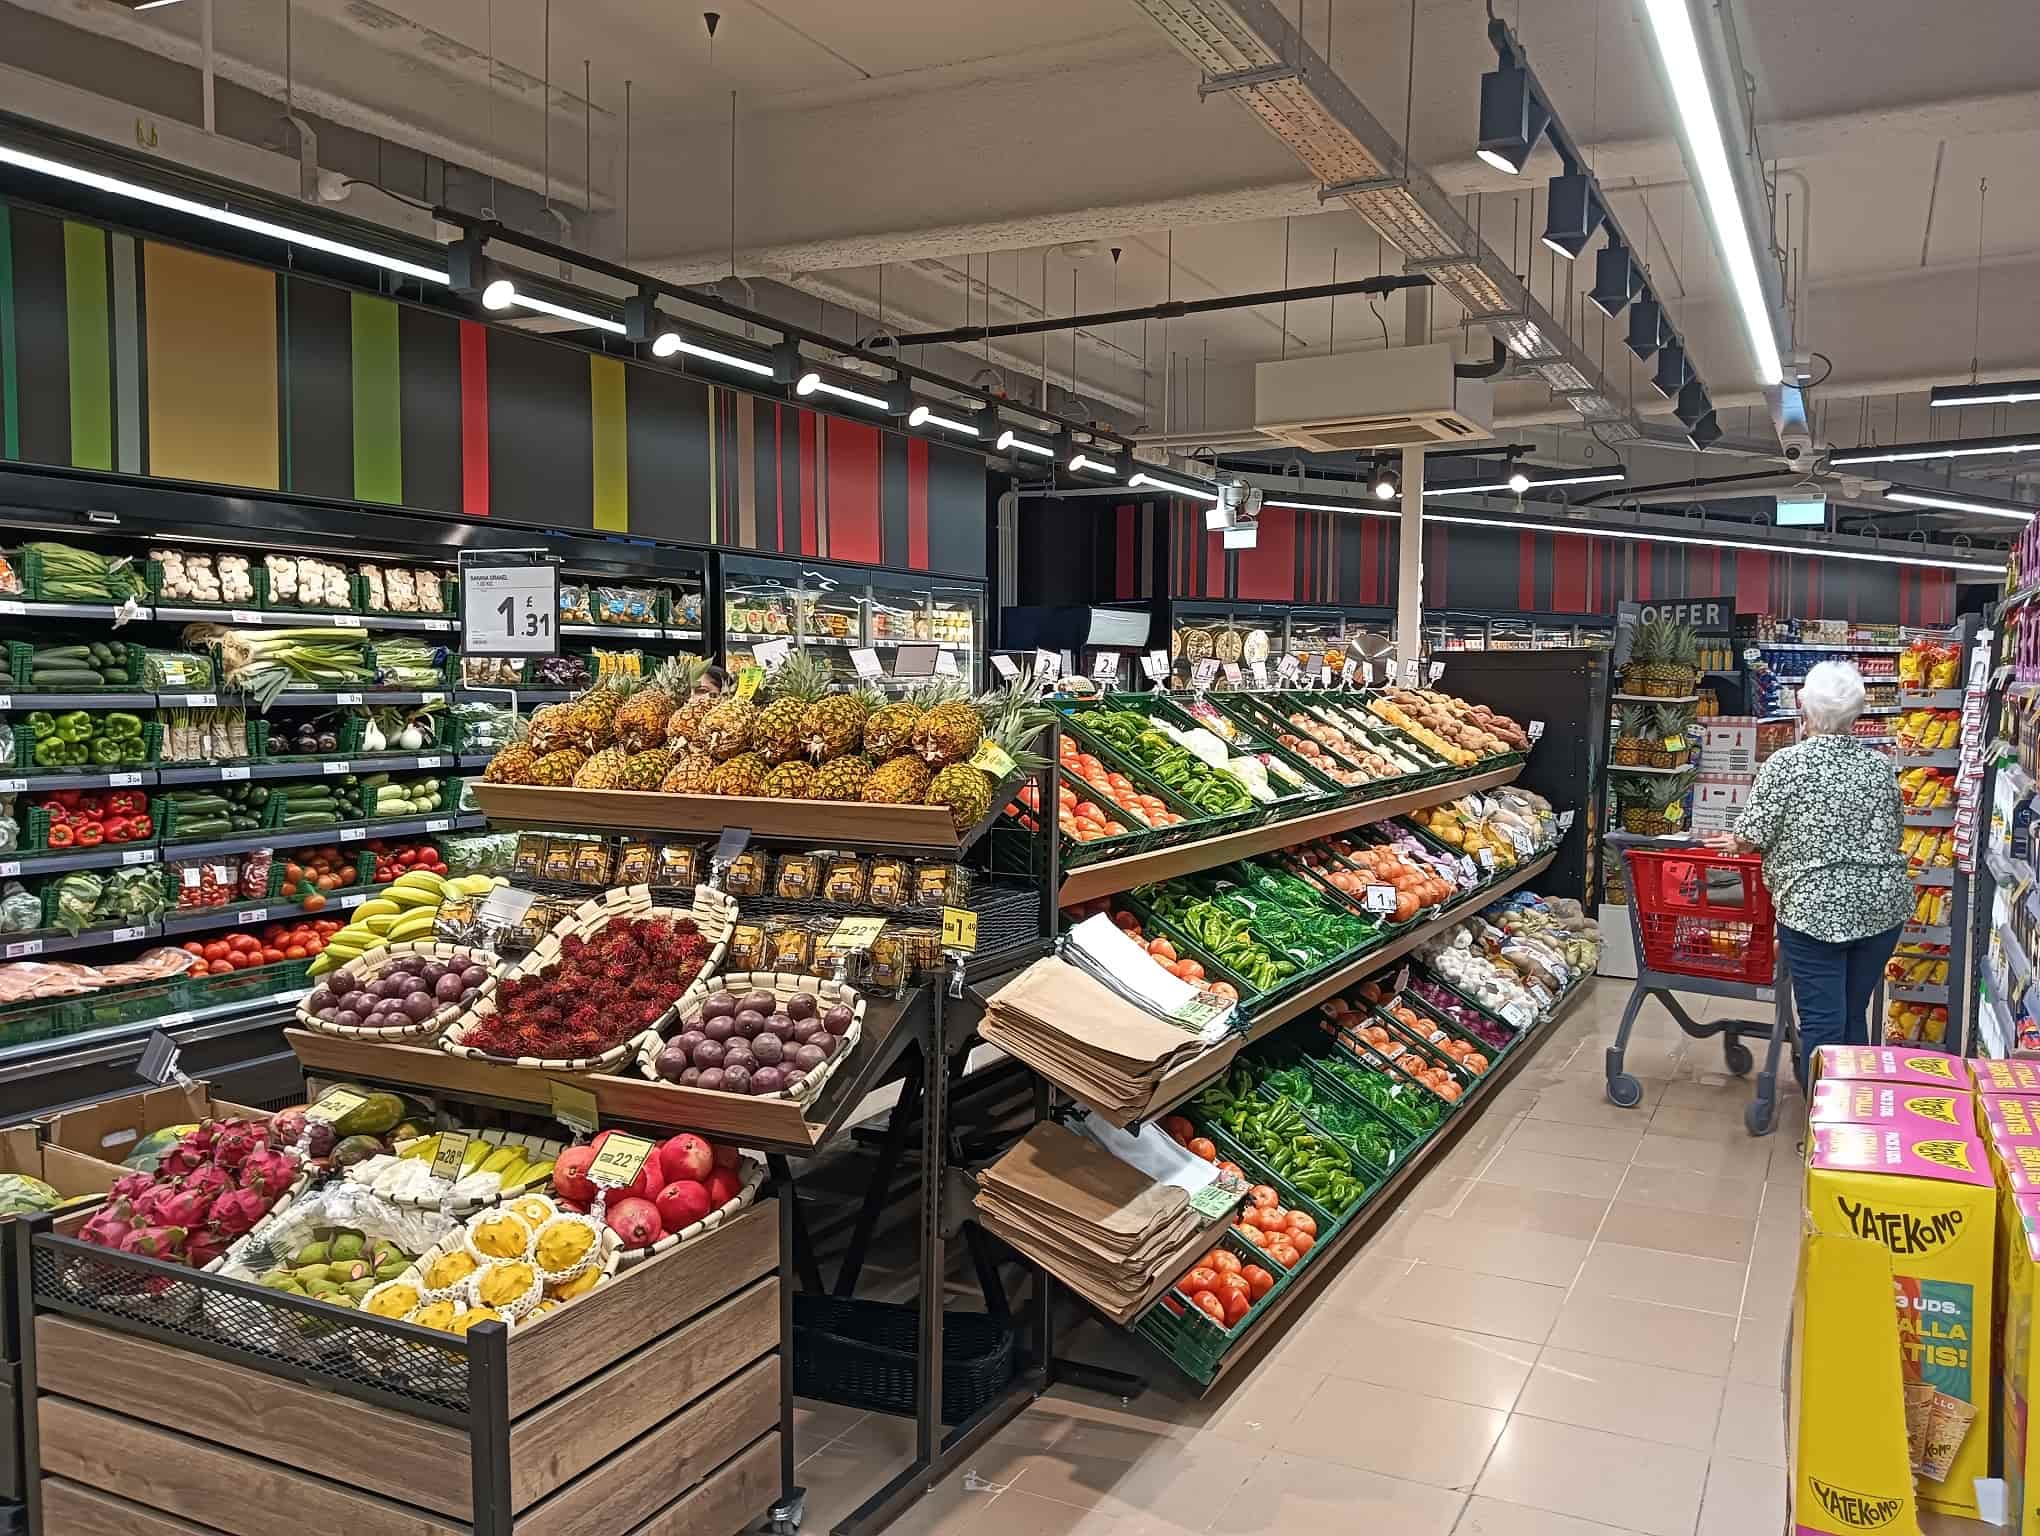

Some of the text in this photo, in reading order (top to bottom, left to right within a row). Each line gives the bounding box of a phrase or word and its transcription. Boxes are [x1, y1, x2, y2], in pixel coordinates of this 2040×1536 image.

[1641, 603, 1720, 626] OFFER
[611, 1152, 633, 1168] 22
[1837, 1195, 1963, 1254] YATEKOMO
[1912, 1296, 1961, 1316] UDS.
[1813, 1481, 1898, 1526] YATEKOMO
